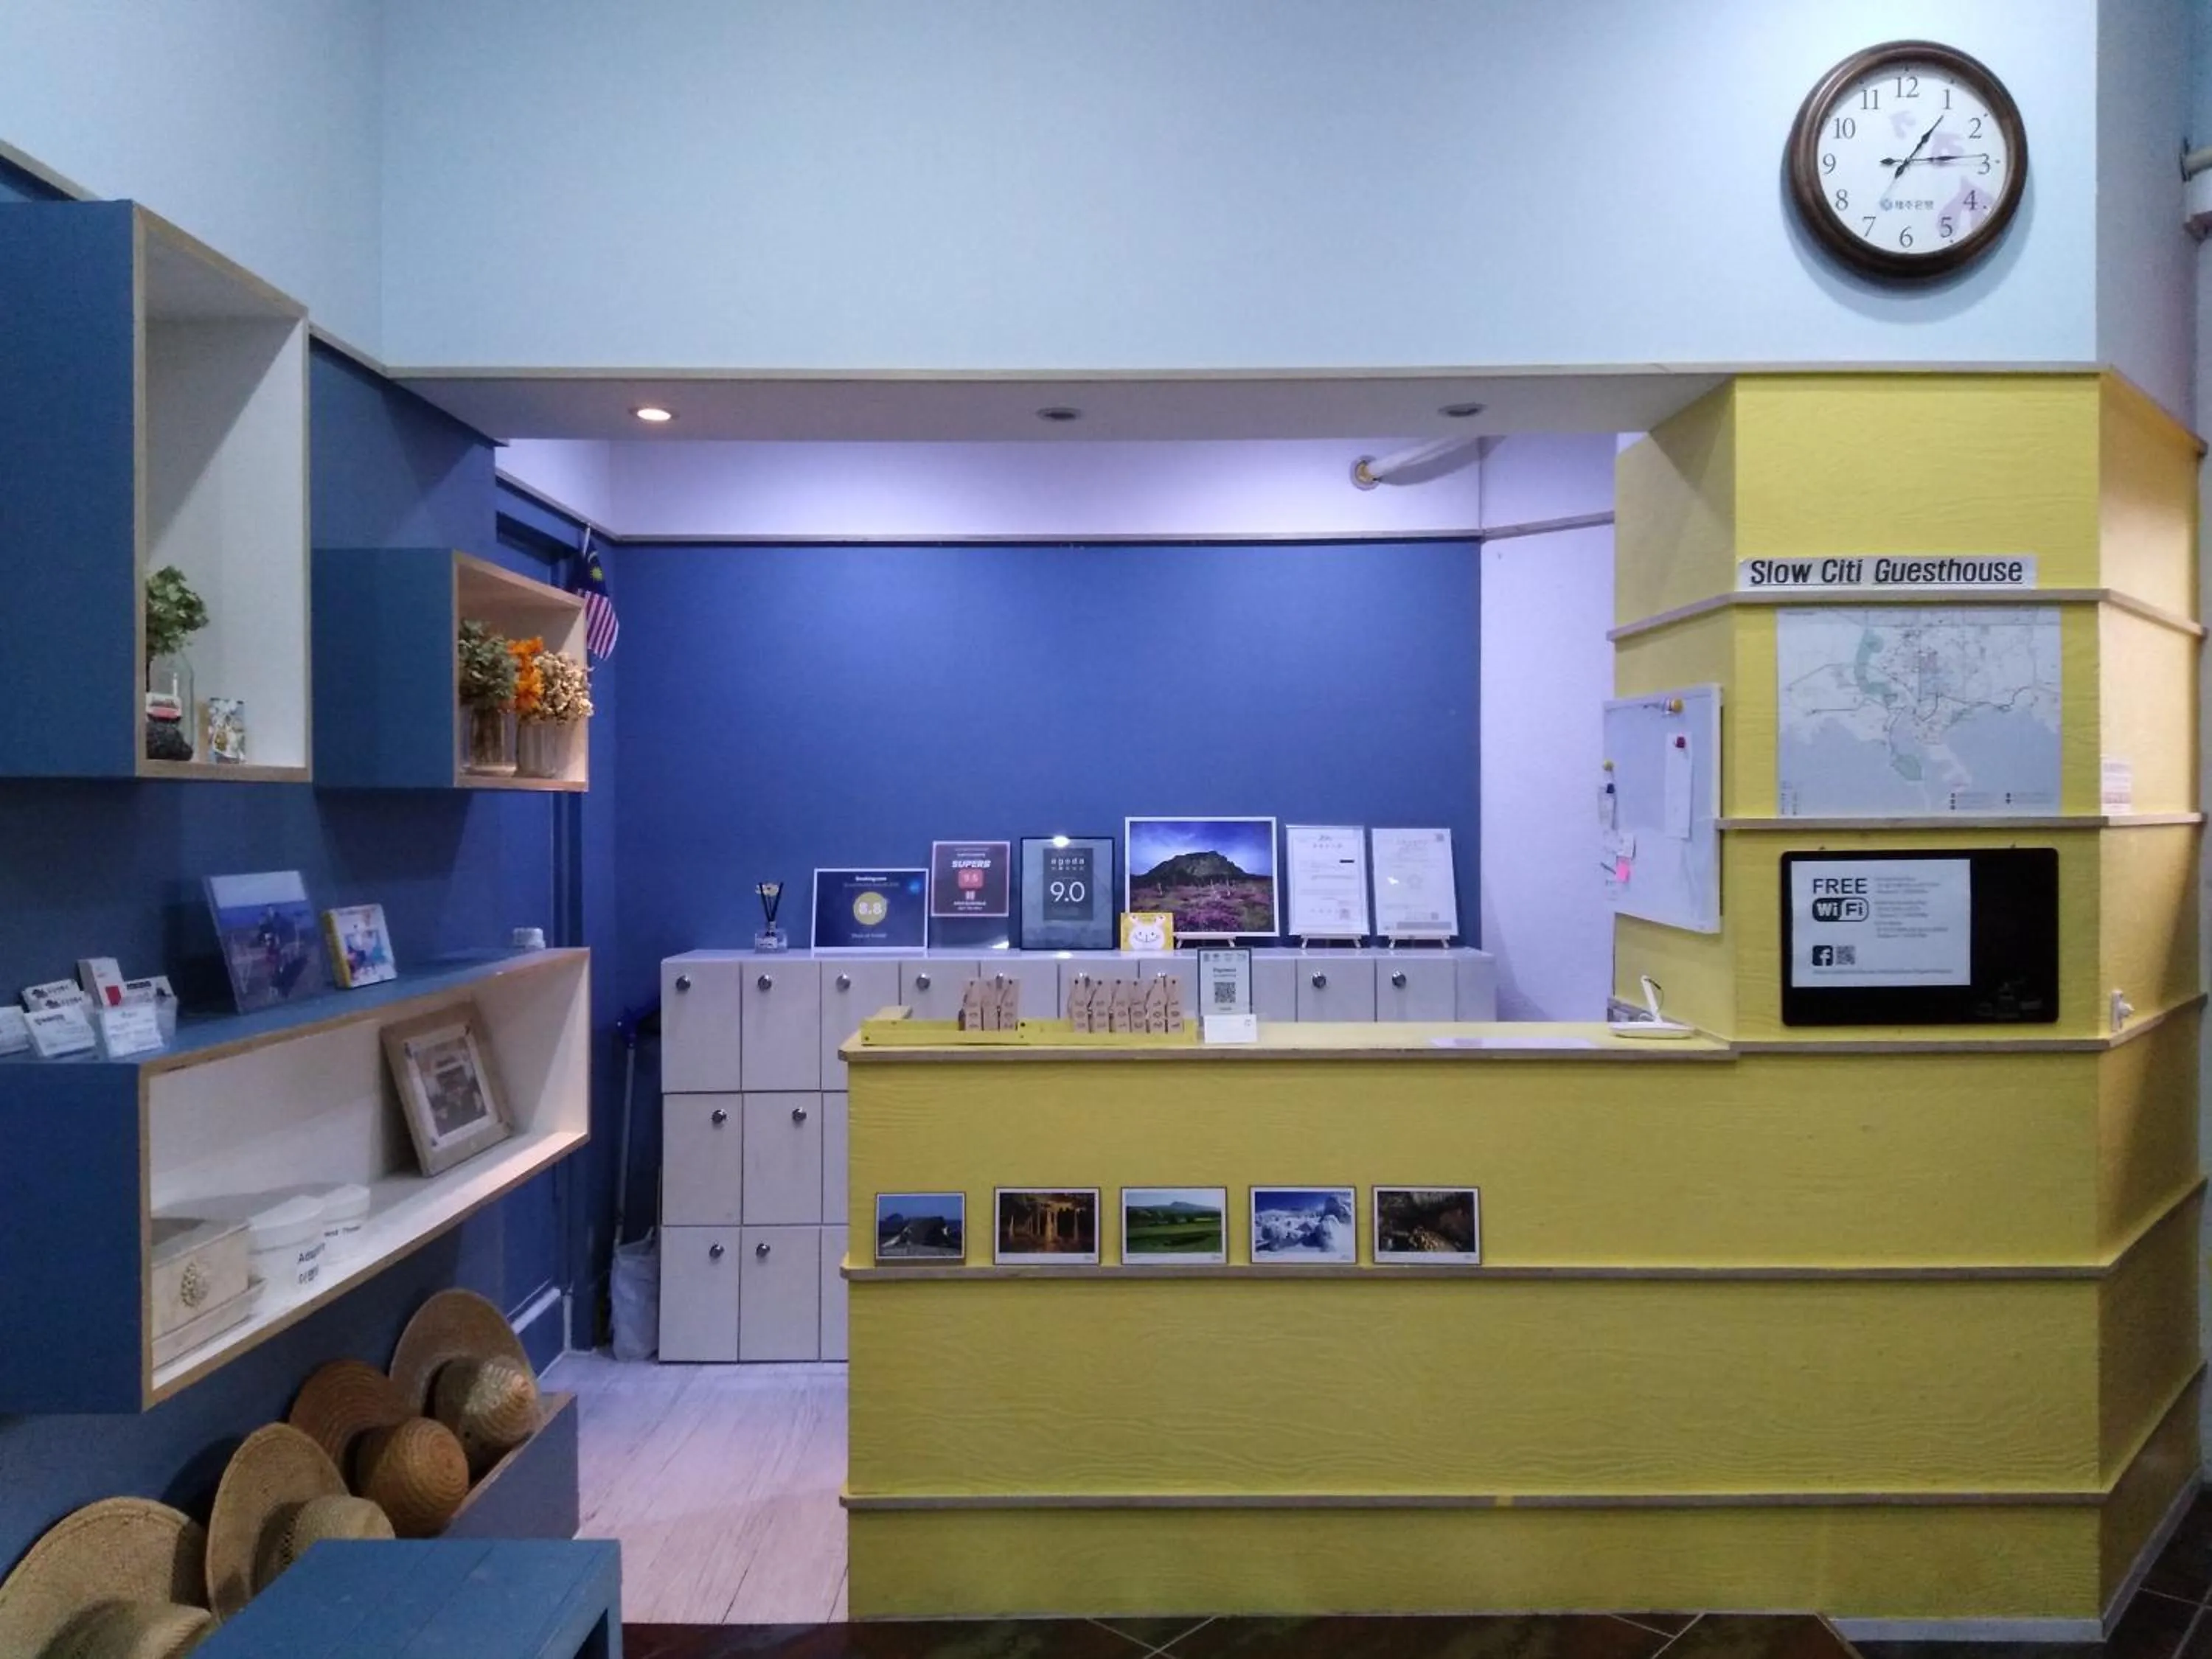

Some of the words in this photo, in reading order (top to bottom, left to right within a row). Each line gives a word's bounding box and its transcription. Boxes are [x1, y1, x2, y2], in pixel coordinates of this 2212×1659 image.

[1896, 76, 1919, 98] 12
[1861, 89, 1879, 110] 11
[1942, 89, 1953, 110] 1
[1833, 117, 1856, 139] 10
[1969, 117, 1982, 139] 2
[1823, 153, 1836, 174] 9
[1978, 153, 1991, 175] 3
[1835, 189, 1848, 210] 8
[1963, 190, 1978, 210] 4
[1863, 216, 1877, 237] 7
[1899, 226, 1913, 248] 6
[1939, 217, 1953, 237] 5
[1750, 560, 1813, 584] Slow
[1821, 558, 1863, 583] Citi
[1874, 558, 2023, 582] Guesthouse
[1050, 881, 1085, 902] 9.0
[1813, 877, 1868, 894] FREE
